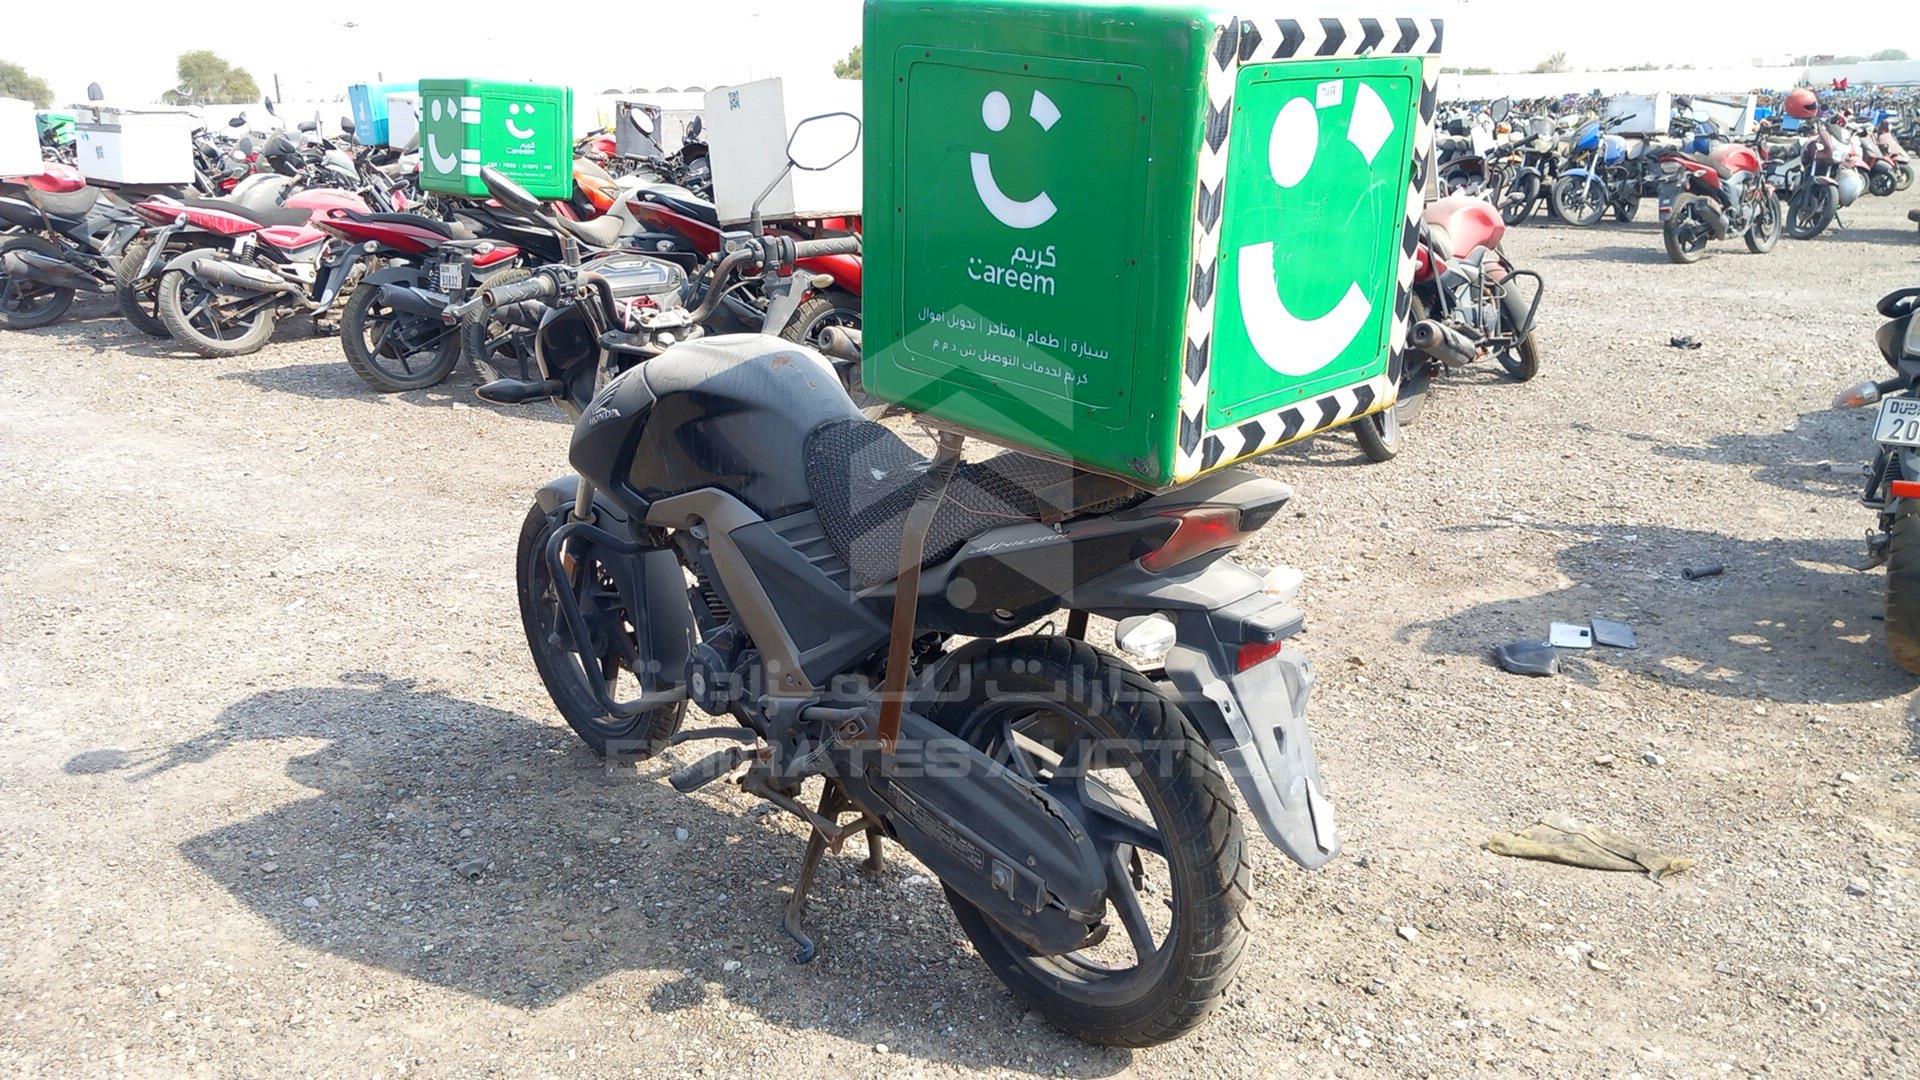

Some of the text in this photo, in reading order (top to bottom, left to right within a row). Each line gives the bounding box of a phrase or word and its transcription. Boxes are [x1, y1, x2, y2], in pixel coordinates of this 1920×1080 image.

[1011, 245, 1056, 270] كريم
[968, 256, 1055, 296] Careem
[986, 321, 1016, 338] متاجر
[1026, 329, 1060, 348] طعام
[1071, 339, 1109, 360] سيارة
[589, 407, 622, 426] HONDA
